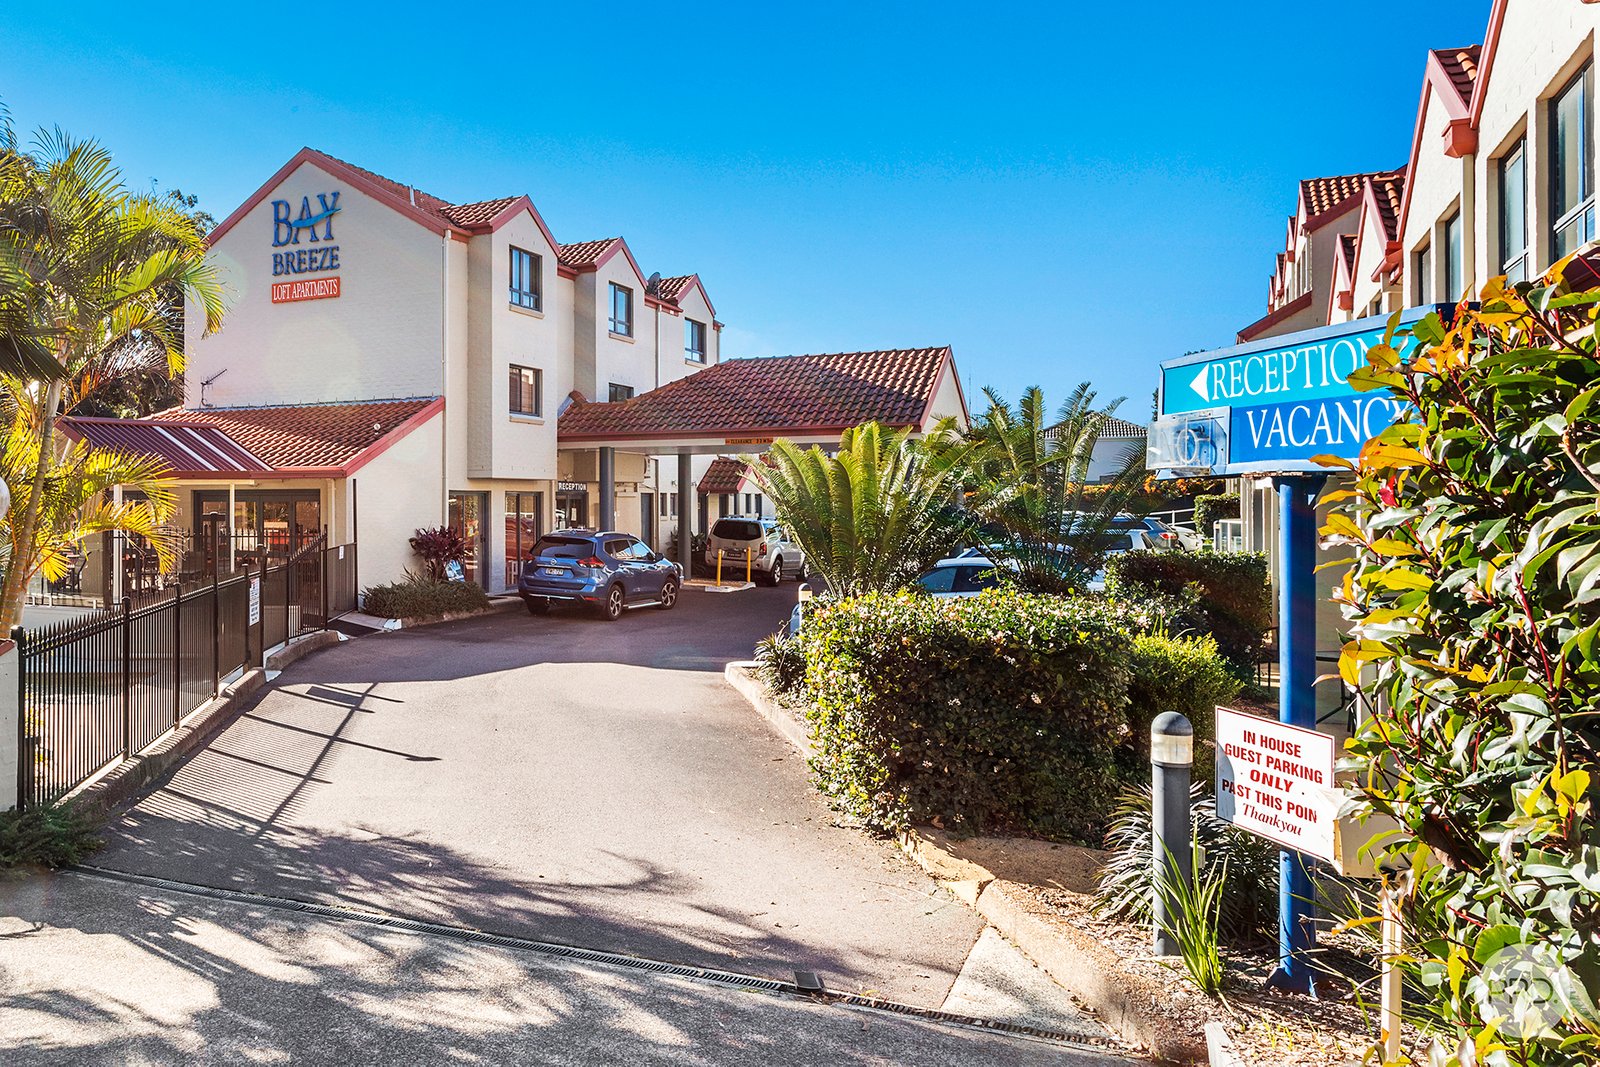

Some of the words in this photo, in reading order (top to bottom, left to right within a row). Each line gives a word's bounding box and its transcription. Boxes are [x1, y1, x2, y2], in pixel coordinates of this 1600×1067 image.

[271, 191, 341, 247] BAY
[272, 246, 340, 276] BREEZE
[273, 284, 291, 300] LOFT
[292, 279, 338, 298] APARTMENTS
[558, 482, 587, 491] RECEPTION
[1243, 730, 1256, 745] IN
[1260, 735, 1301, 758] HOUSE
[1225, 743, 1262, 765] GUEST
[1266, 755, 1323, 784] PARKING
[1250, 769, 1294, 793] ONLY
[1222, 779, 1251, 799] PAST
[1255, 790, 1282, 811] THIS
[1287, 801, 1317, 824] POIN
[1242, 803, 1301, 836] Thankyou
